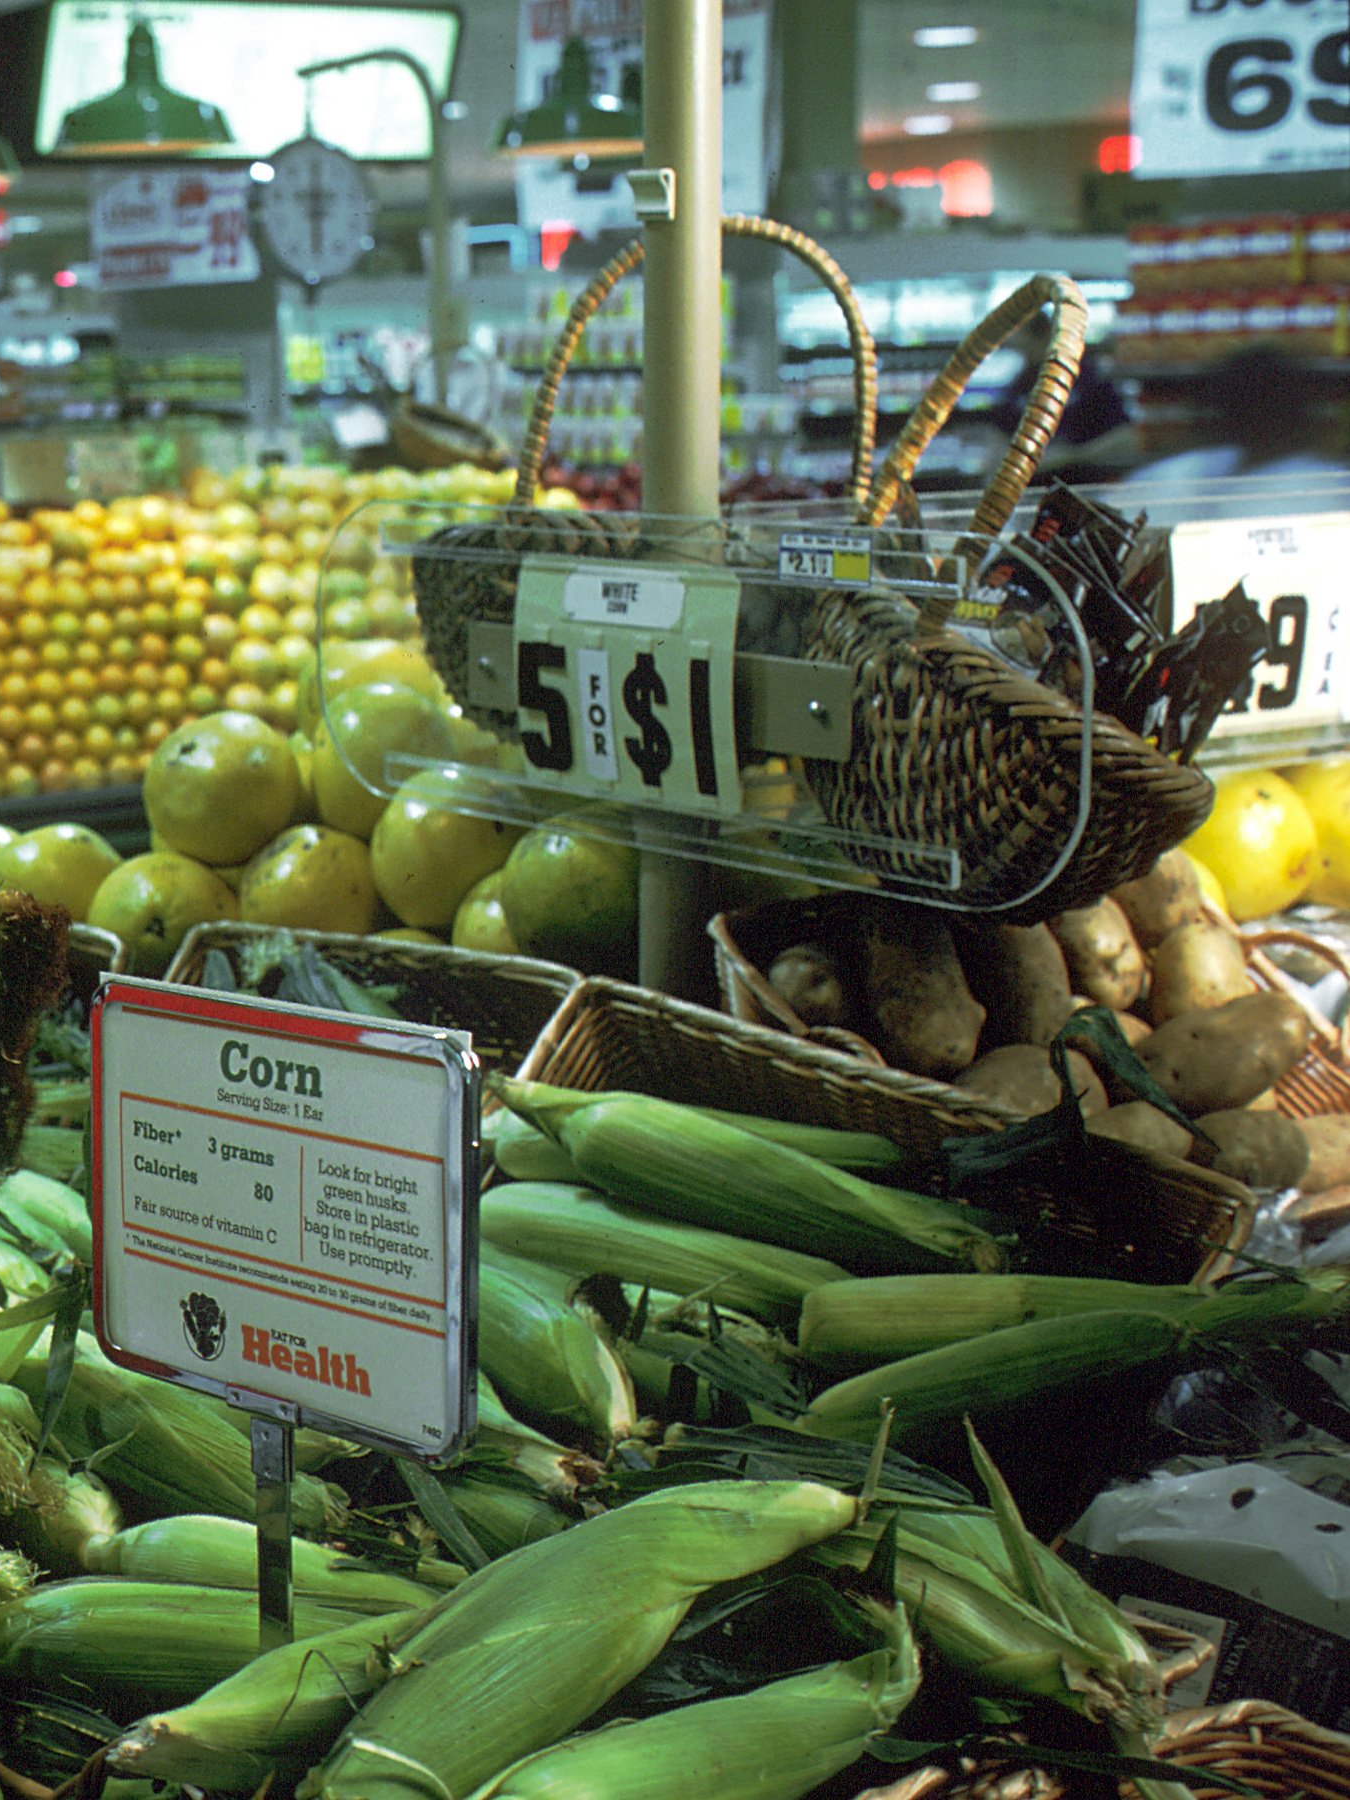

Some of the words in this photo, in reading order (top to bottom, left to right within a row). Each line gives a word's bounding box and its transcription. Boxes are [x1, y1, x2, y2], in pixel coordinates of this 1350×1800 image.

[602, 582, 638, 602] WHITE
[518, 640, 574, 772] 5
[588, 674, 607, 757] FOR
[622, 651, 719, 797] $1
[219, 1039, 323, 1098] Corn
[217, 1088, 261, 1112] Serving
[262, 1096, 291, 1115] Size:
[293, 1103, 300, 1118] 1
[302, 1105, 323, 1122] Ear
[208, 1136, 217, 1154] 3
[220, 1142, 275, 1167] grams
[133, 1154, 198, 1184] Calories
[253, 1181, 274, 1202] 80
[318, 1158, 351, 1181] Look
[352, 1166, 371, 1185] for
[374, 1170, 418, 1196] bright
[316, 1200, 352, 1221] Store
[354, 1208, 368, 1226] in
[370, 1213, 419, 1237] plastic
[323, 1184, 363, 1204] green
[365, 1189, 411, 1214] husks.
[134, 1195, 157, 1215] Fair
[159, 1206, 199, 1225] source
[201, 1213, 215, 1230] of
[215, 1217, 265, 1241] vitamin
[266, 1228, 278, 1244] C
[302, 1216, 329, 1239] bag
[332, 1224, 346, 1241] in
[348, 1229, 434, 1261] refrigerator.
[132, 1235, 146, 1247] The
[146, 1238, 177, 1258] National
[177, 1247, 204, 1263] Cancer
[205, 1254, 238, 1272] Institute
[238, 1264, 290, 1285] recommends
[290, 1277, 317, 1294] eating
[317, 1282, 328, 1295] 20
[328, 1287, 338, 1298] to
[350, 1294, 377, 1309] grams
[378, 1299, 388, 1310] of
[388, 1301, 408, 1316] fiber
[319, 1240, 346, 1260] Use
[348, 1250, 418, 1280] promptly.
[270, 1328, 289, 1343] EAT
[289, 1332, 307, 1349] FOR
[240, 1322, 372, 1398] Health
